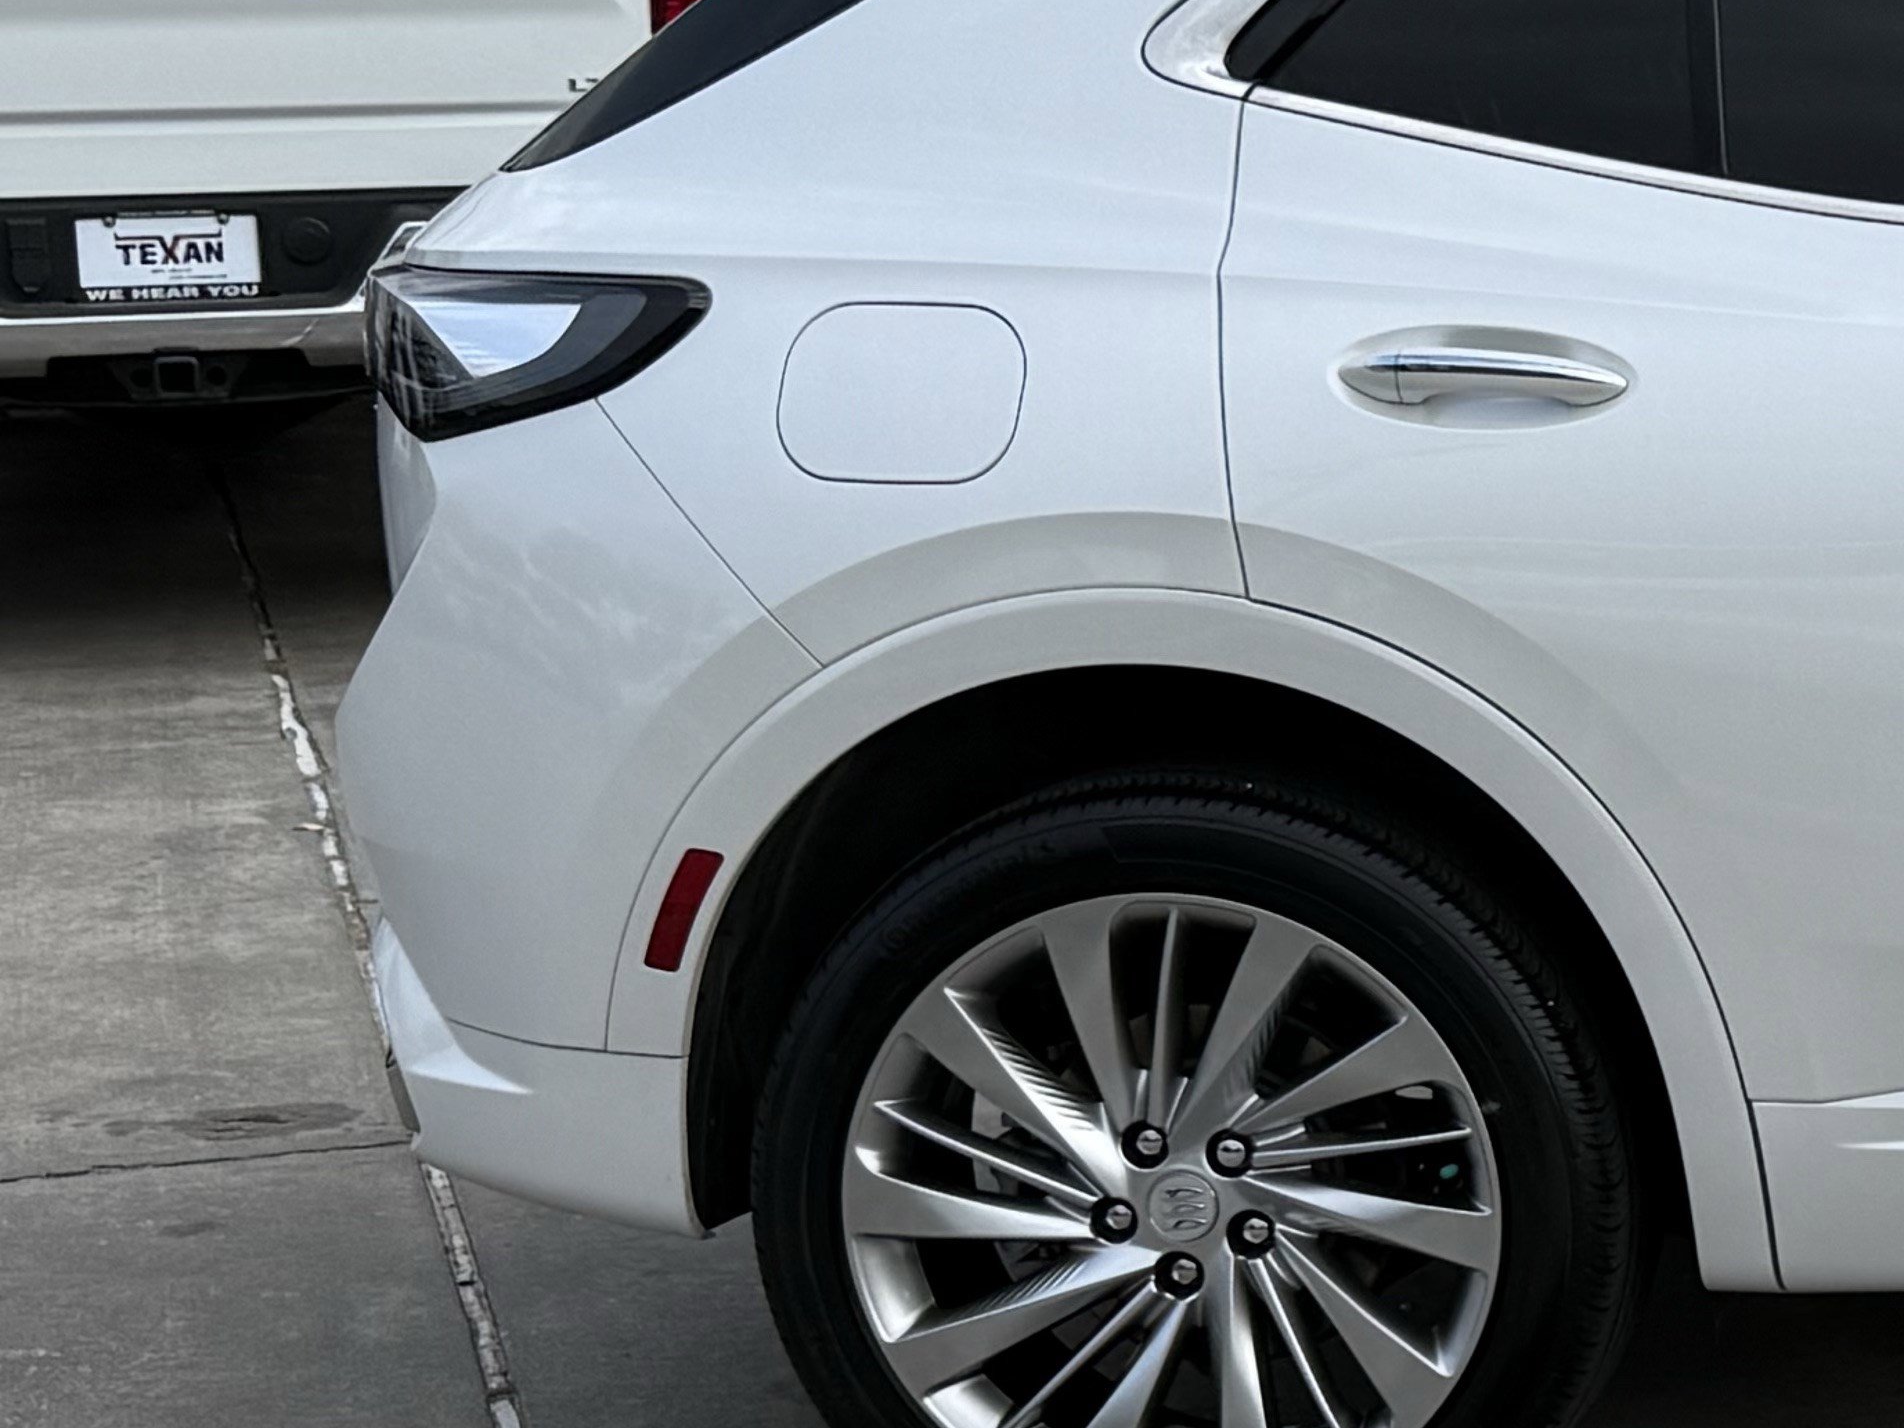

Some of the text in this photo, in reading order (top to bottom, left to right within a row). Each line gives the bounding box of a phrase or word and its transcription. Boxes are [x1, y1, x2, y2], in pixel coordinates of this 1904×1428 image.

[114, 233, 224, 266] TEXAN
[86, 284, 259, 301] WE HEAR YOU
